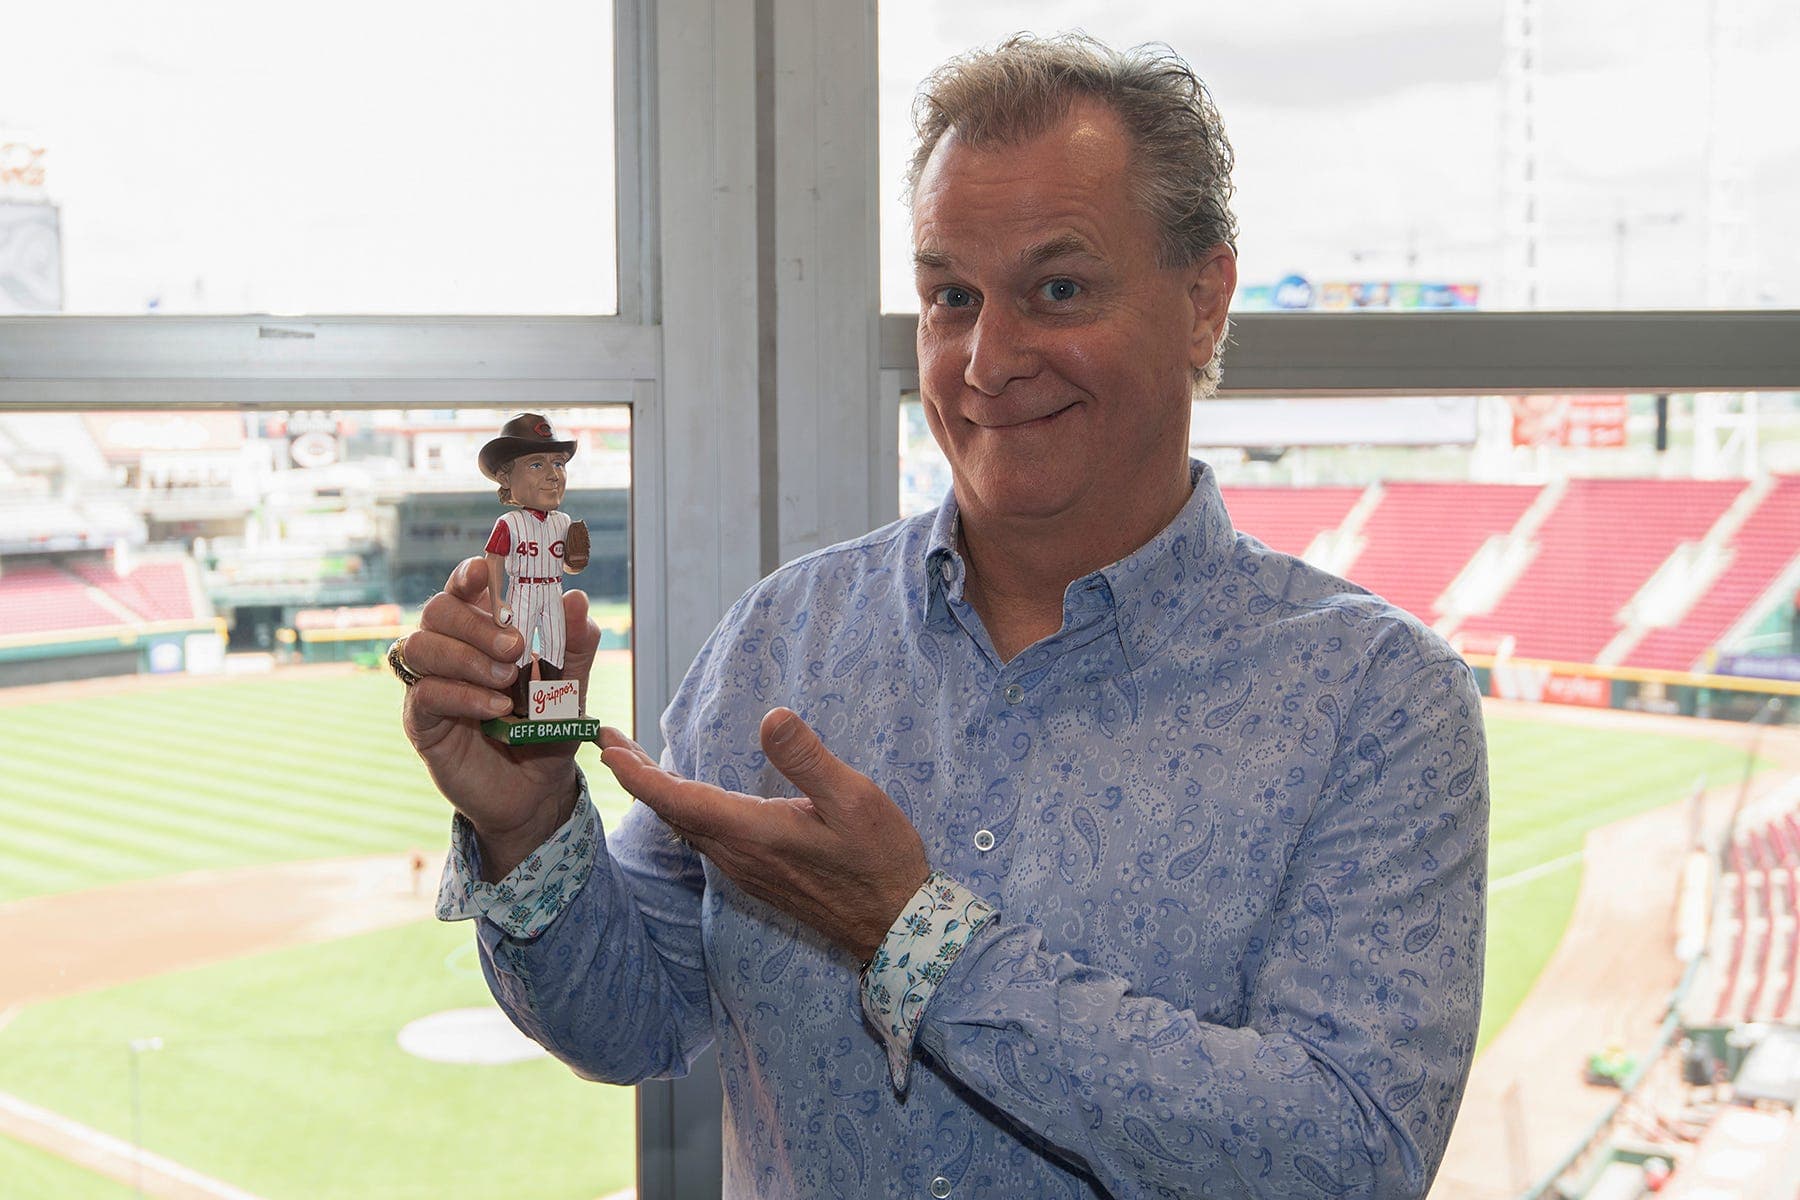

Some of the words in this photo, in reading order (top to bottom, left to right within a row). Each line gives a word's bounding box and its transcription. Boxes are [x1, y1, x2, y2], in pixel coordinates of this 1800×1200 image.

[516, 541, 539, 557] 45
[533, 682, 574, 714] Grippo's
[538, 723, 600, 737] BRANTLEY
